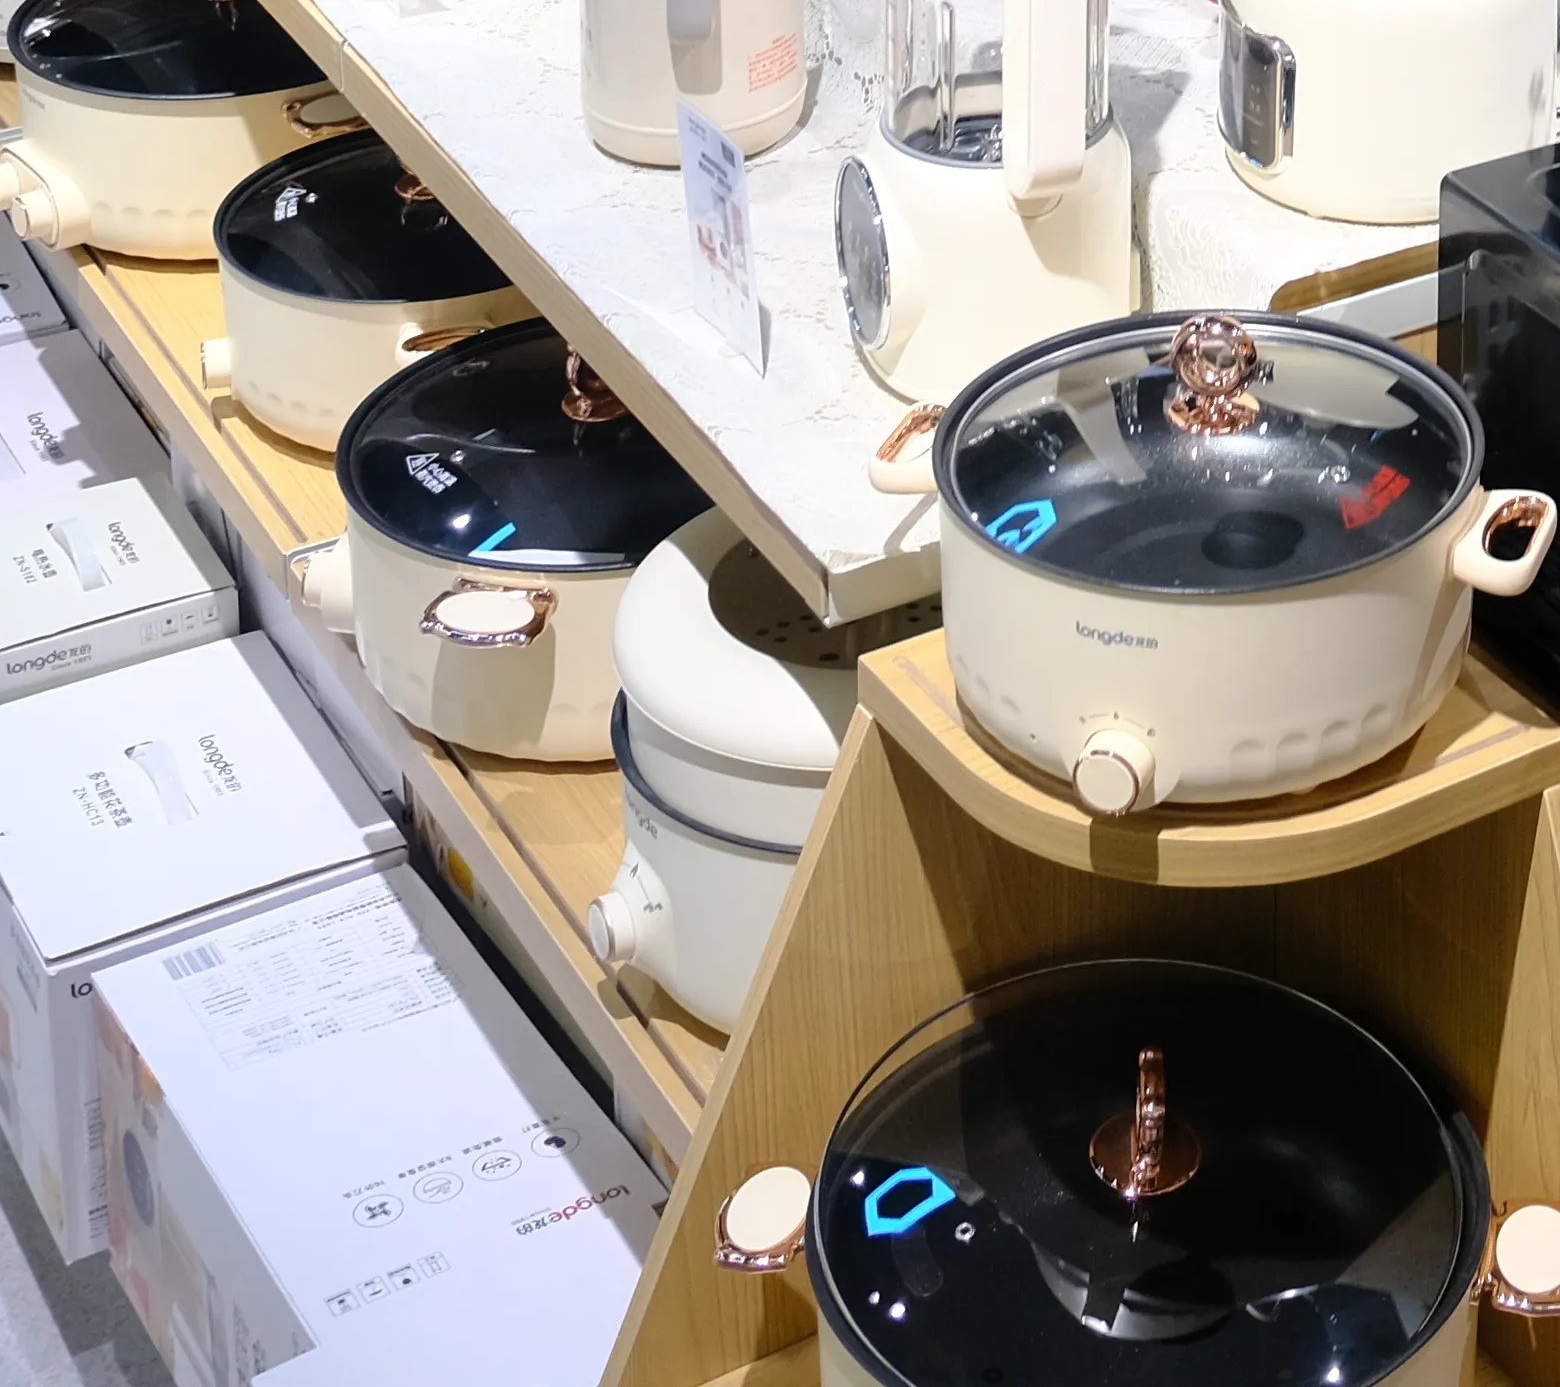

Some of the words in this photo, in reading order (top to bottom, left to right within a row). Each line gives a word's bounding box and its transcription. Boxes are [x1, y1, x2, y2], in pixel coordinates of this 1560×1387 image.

[1075, 621, 1160, 651] longde龙的
[6, 643, 92, 676] longde龙的
[197, 733, 243, 795] longde龙的
[515, 1184, 632, 1236] longde龙的
